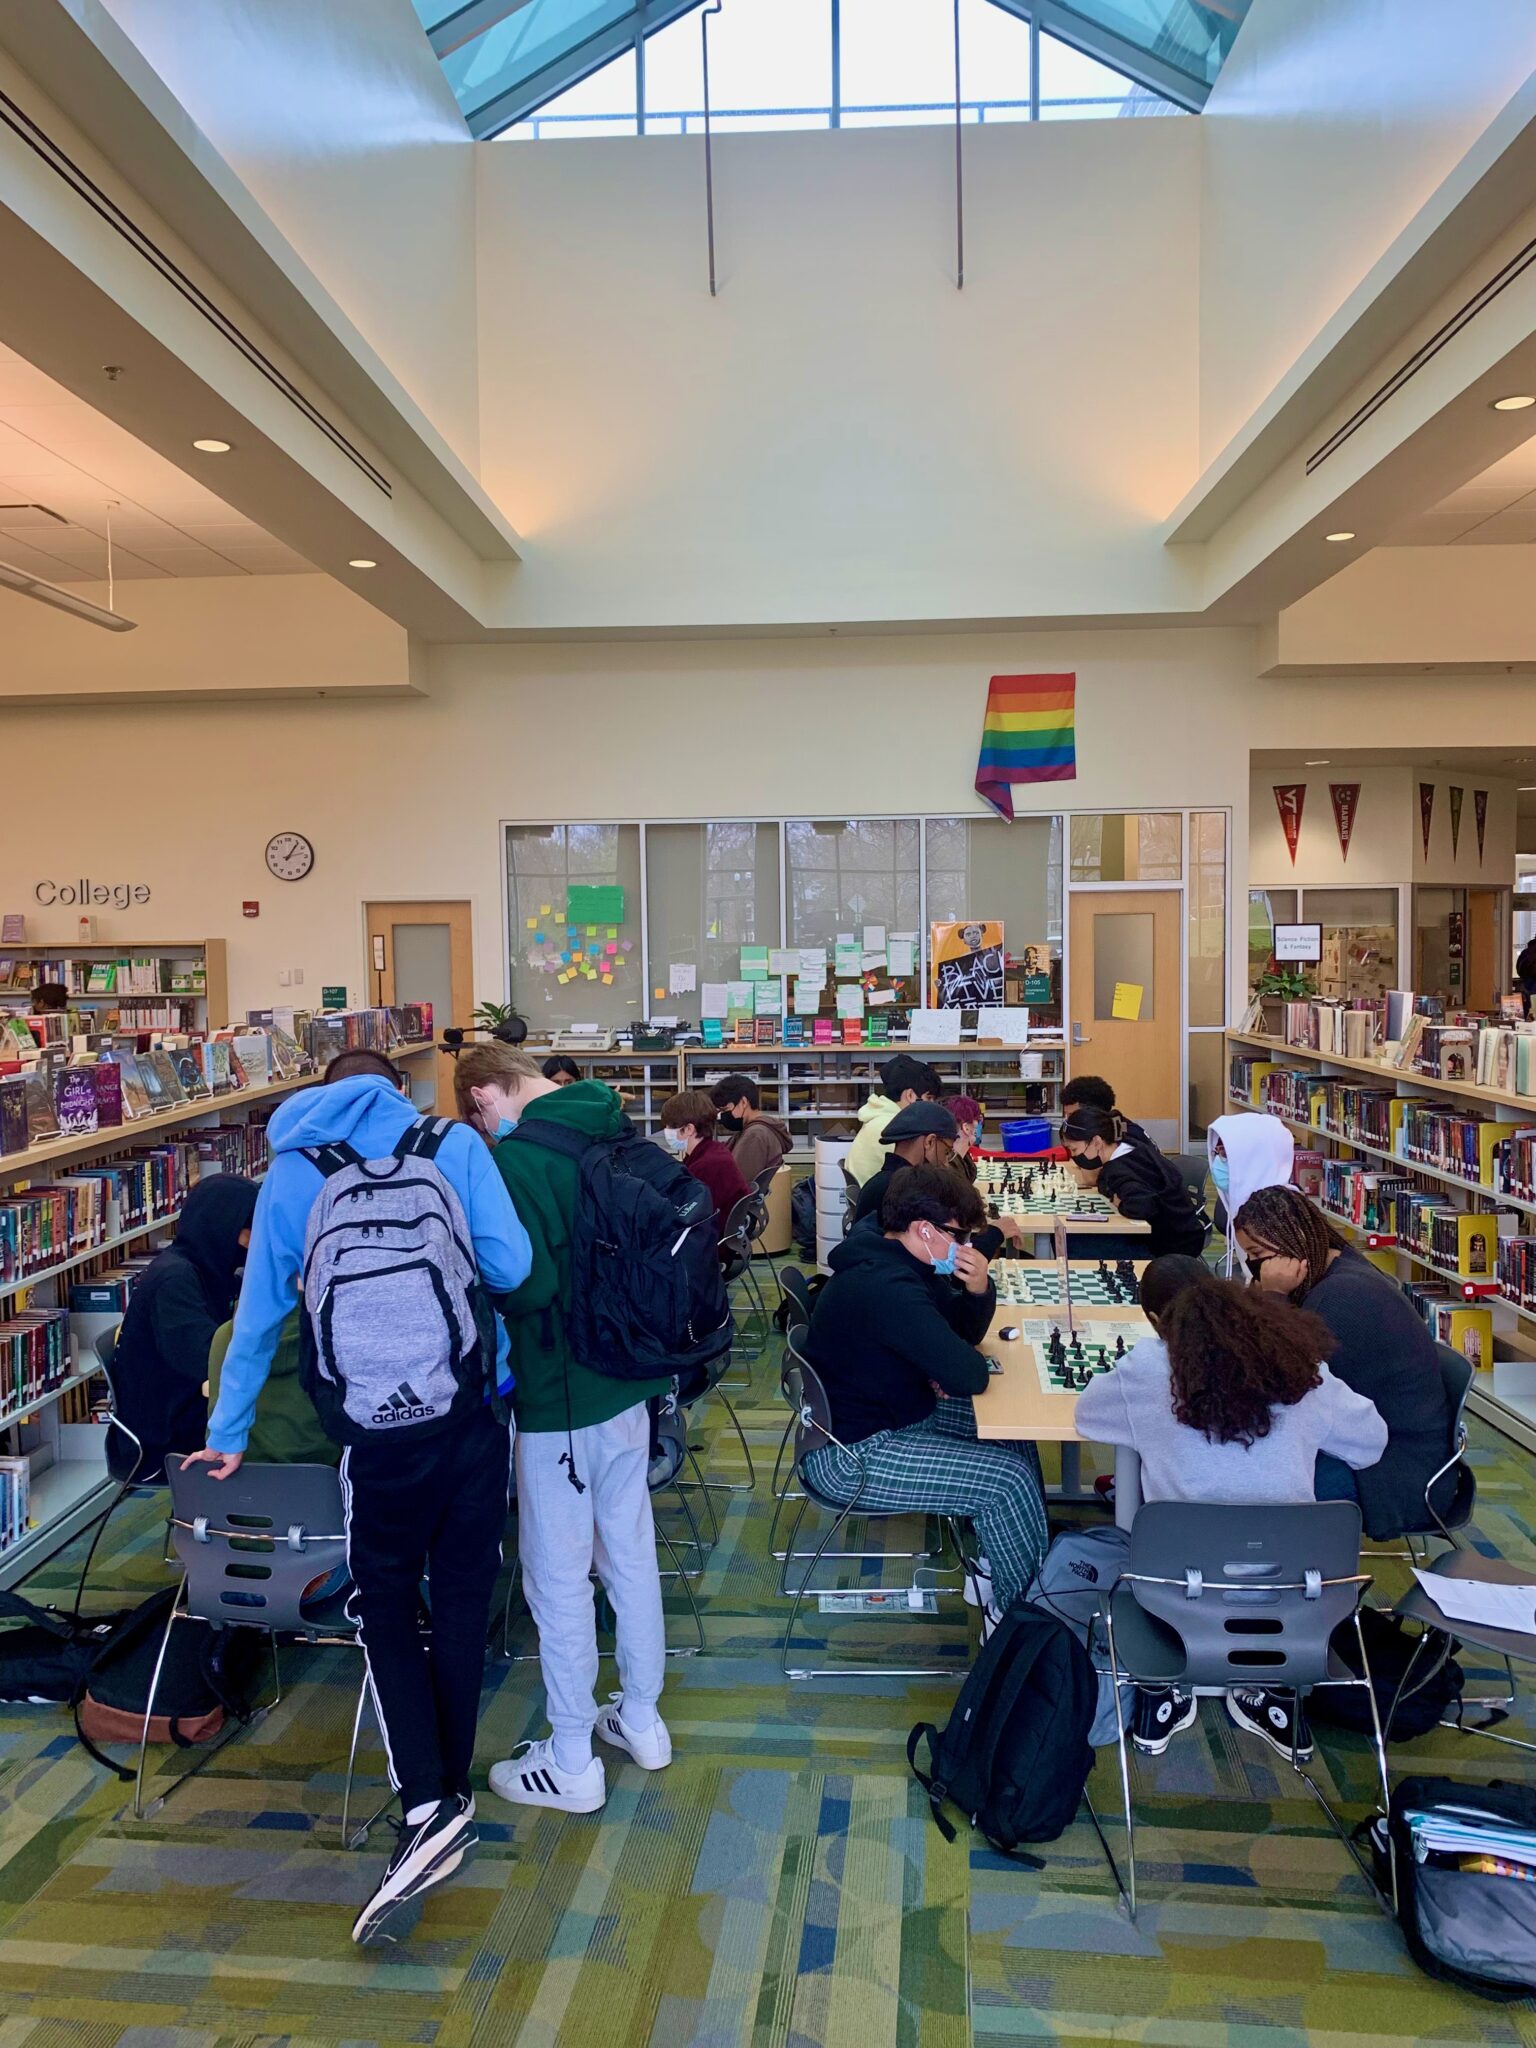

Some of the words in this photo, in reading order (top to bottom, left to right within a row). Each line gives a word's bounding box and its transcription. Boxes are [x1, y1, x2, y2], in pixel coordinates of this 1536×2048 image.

[1341, 804, 1349, 840] HARVARD
[36, 878, 151, 910] College
[68, 1074, 80, 1085] The
[64, 1085, 85, 1097] GIRL
[61, 1095, 96, 1109] MIDNIGHT
[371, 1405, 436, 1424] adidas
[1068, 1560, 1089, 1575] NORTH
[1071, 1567, 1087, 1579] FACE
